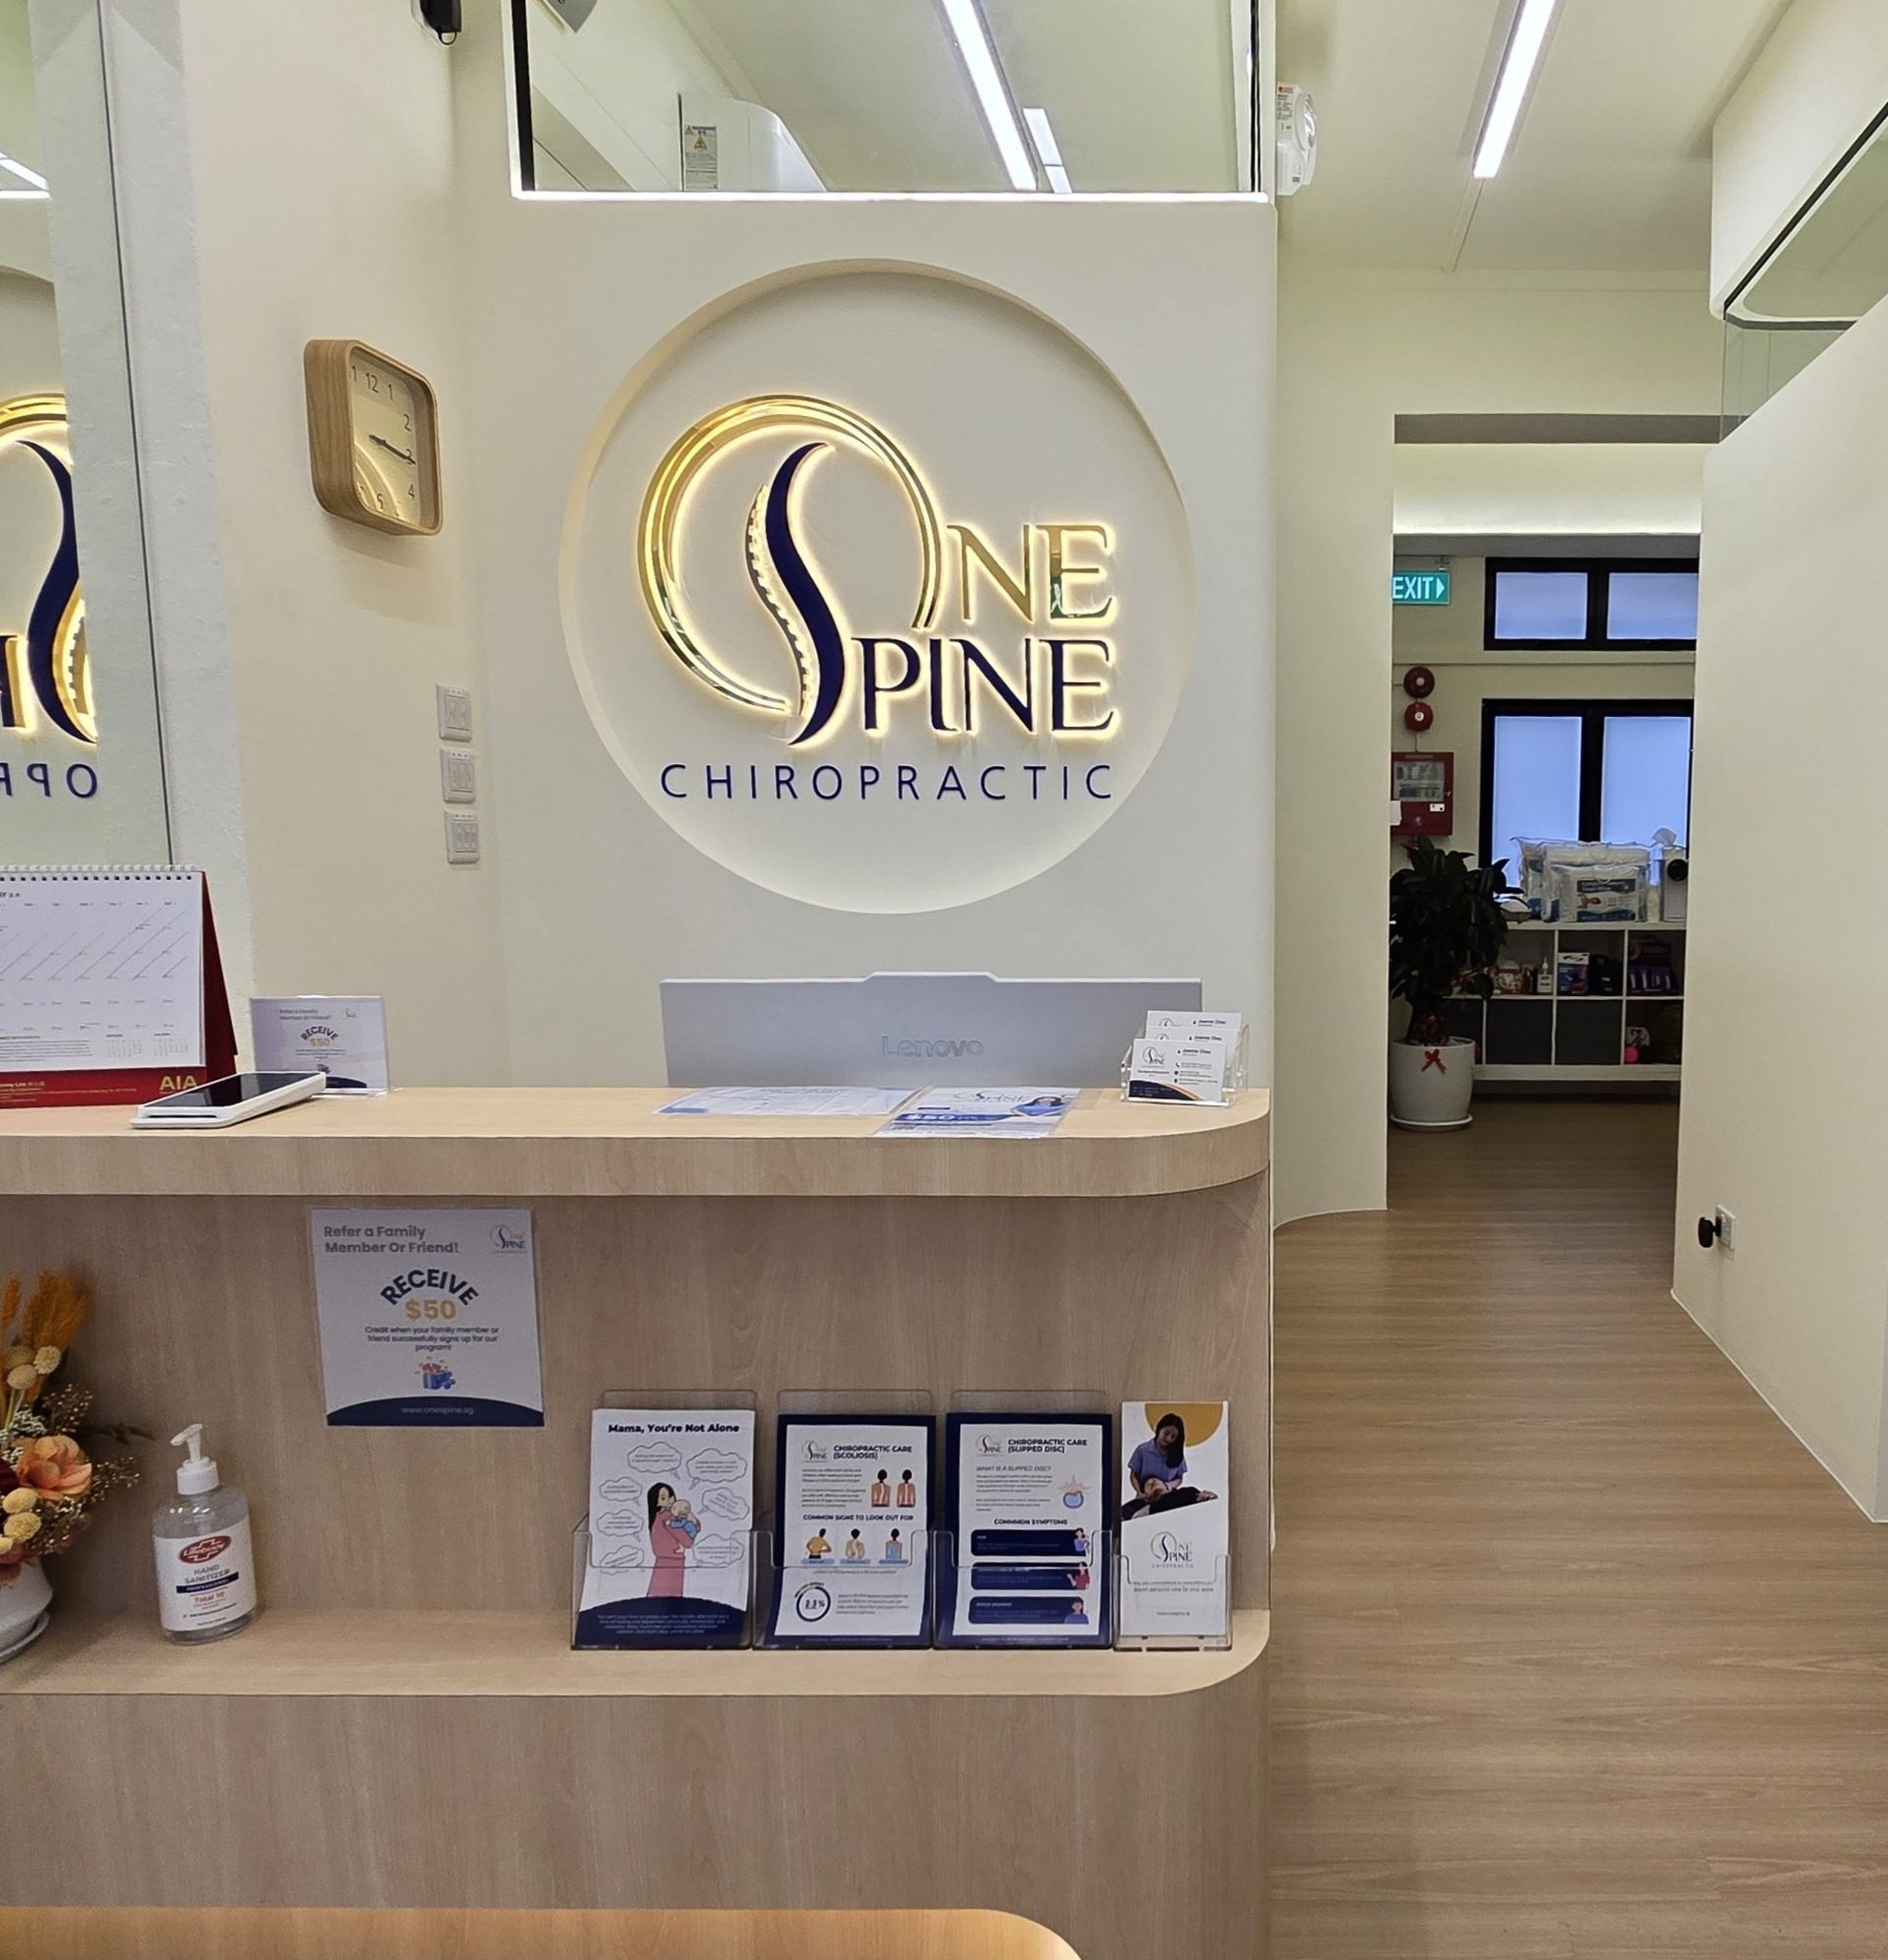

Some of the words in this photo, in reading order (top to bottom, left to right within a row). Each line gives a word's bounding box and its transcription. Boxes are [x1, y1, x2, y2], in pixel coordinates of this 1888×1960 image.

[365, 372, 380, 394] 12
[387, 384, 394, 401] 1
[403, 413, 412, 432] 2
[749, 442, 1115, 745] SPINE
[1392, 576, 1433, 600] EXIT
[660, 763, 1113, 802] CHIROPRACTIC
[300, 1026, 339, 1040] RECEIVE
[881, 1035, 984, 1058] Lenovo
[159, 1075, 197, 1091] AIA
[324, 1225, 363, 1237] Refer
[364, 1228, 375, 1237] a
[377, 1225, 427, 1240] Family
[325, 1242, 385, 1254] Member
[388, 1242, 406, 1254] Or
[409, 1241, 459, 1254] Friend!
[380, 1268, 480, 1306] RECEIVE
[404, 1298, 456, 1322] $50
[391, 1335, 438, 1343] successfully
[440, 1335, 459, 1343] signs
[472, 1334, 483, 1342] for
[431, 1326, 455, 1335] family
[608, 1424, 645, 1434] Mama,
[646, 1423, 682, 1433] You're
[684, 1424, 705, 1433] Not
[707, 1423, 740, 1433] Alone
[833, 1444, 891, 1453] CHIROPRACTIC
[833, 1452, 879, 1460] (SCOLIOSIS)
[184, 1568, 231, 1584] SANITIZER
[194, 1564, 220, 1575] HAND
[195, 1594, 214, 1603] Total
